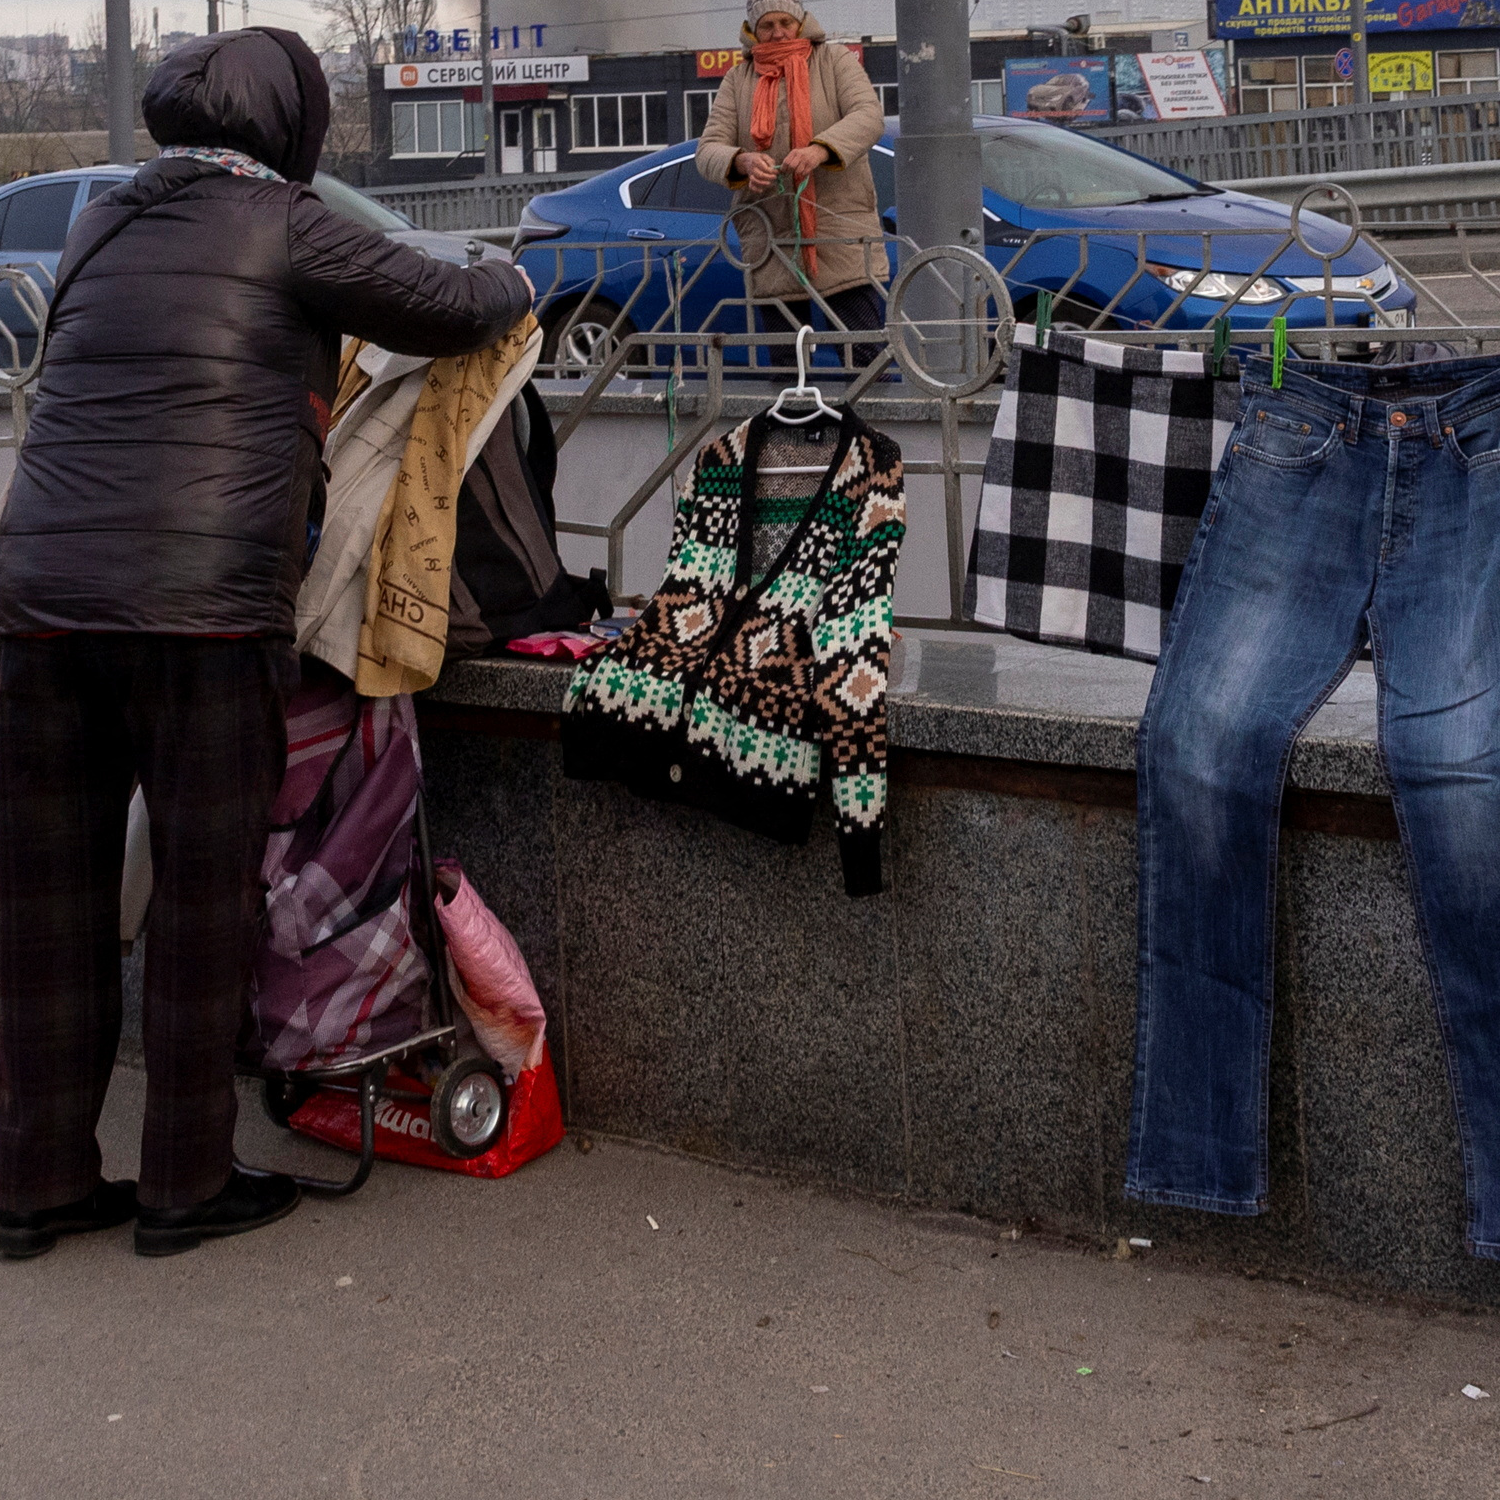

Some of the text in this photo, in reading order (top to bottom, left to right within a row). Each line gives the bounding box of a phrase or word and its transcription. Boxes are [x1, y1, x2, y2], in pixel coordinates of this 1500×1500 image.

[700, 50, 743, 70] ОРЕ
[427, 61, 570, 84] СЕРВІСИЙ ЦЕНТР
